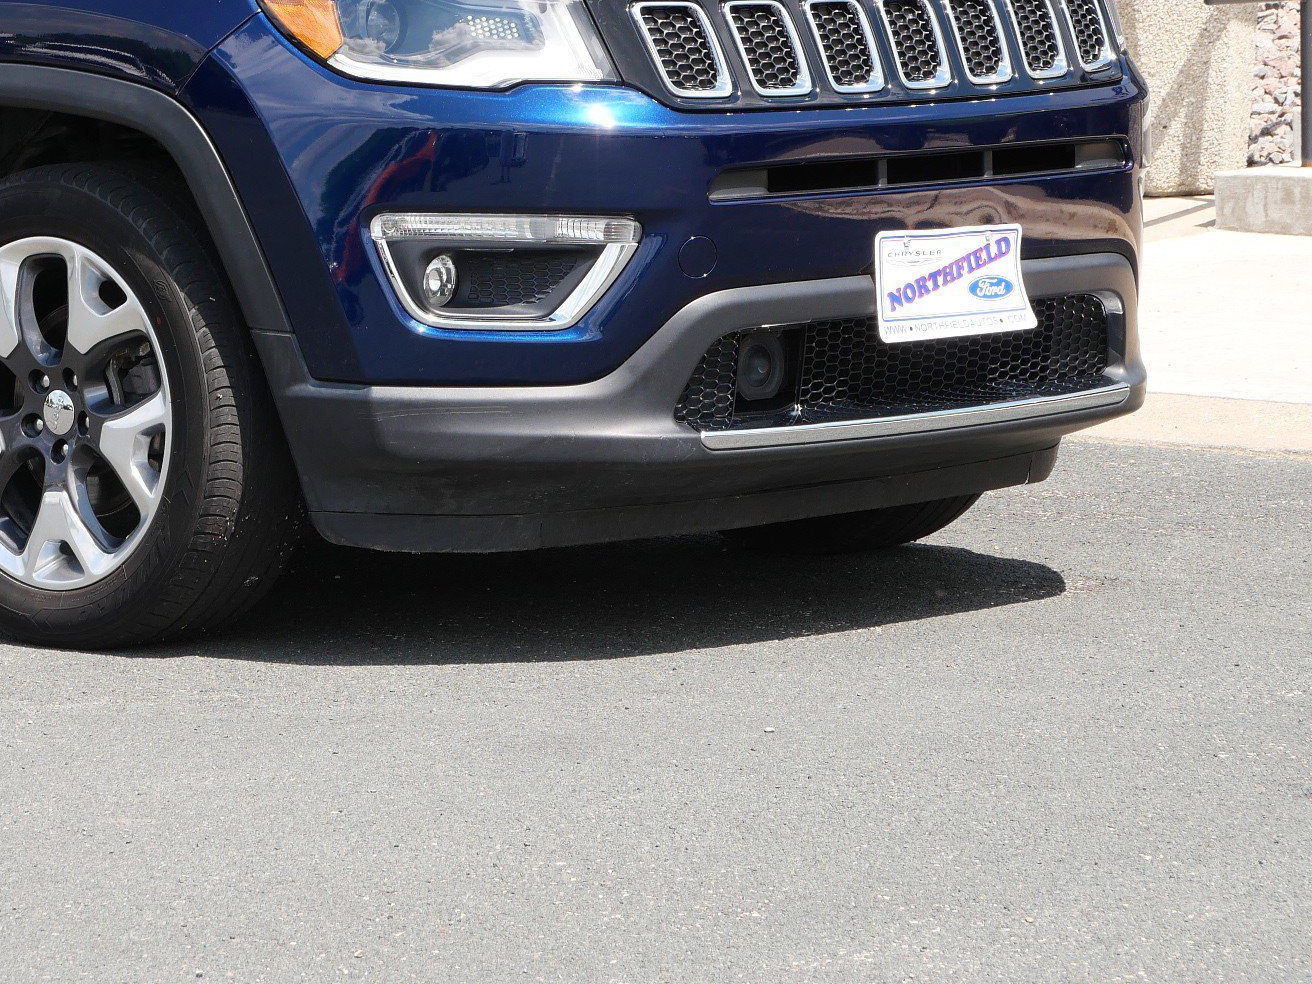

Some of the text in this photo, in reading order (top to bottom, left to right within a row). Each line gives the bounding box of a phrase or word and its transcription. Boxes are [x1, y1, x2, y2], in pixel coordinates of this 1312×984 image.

[887, 249, 942, 258] CHRYSLER
[886, 236, 1012, 313] NORTHFIELD
[976, 277, 1006, 297] Ford
